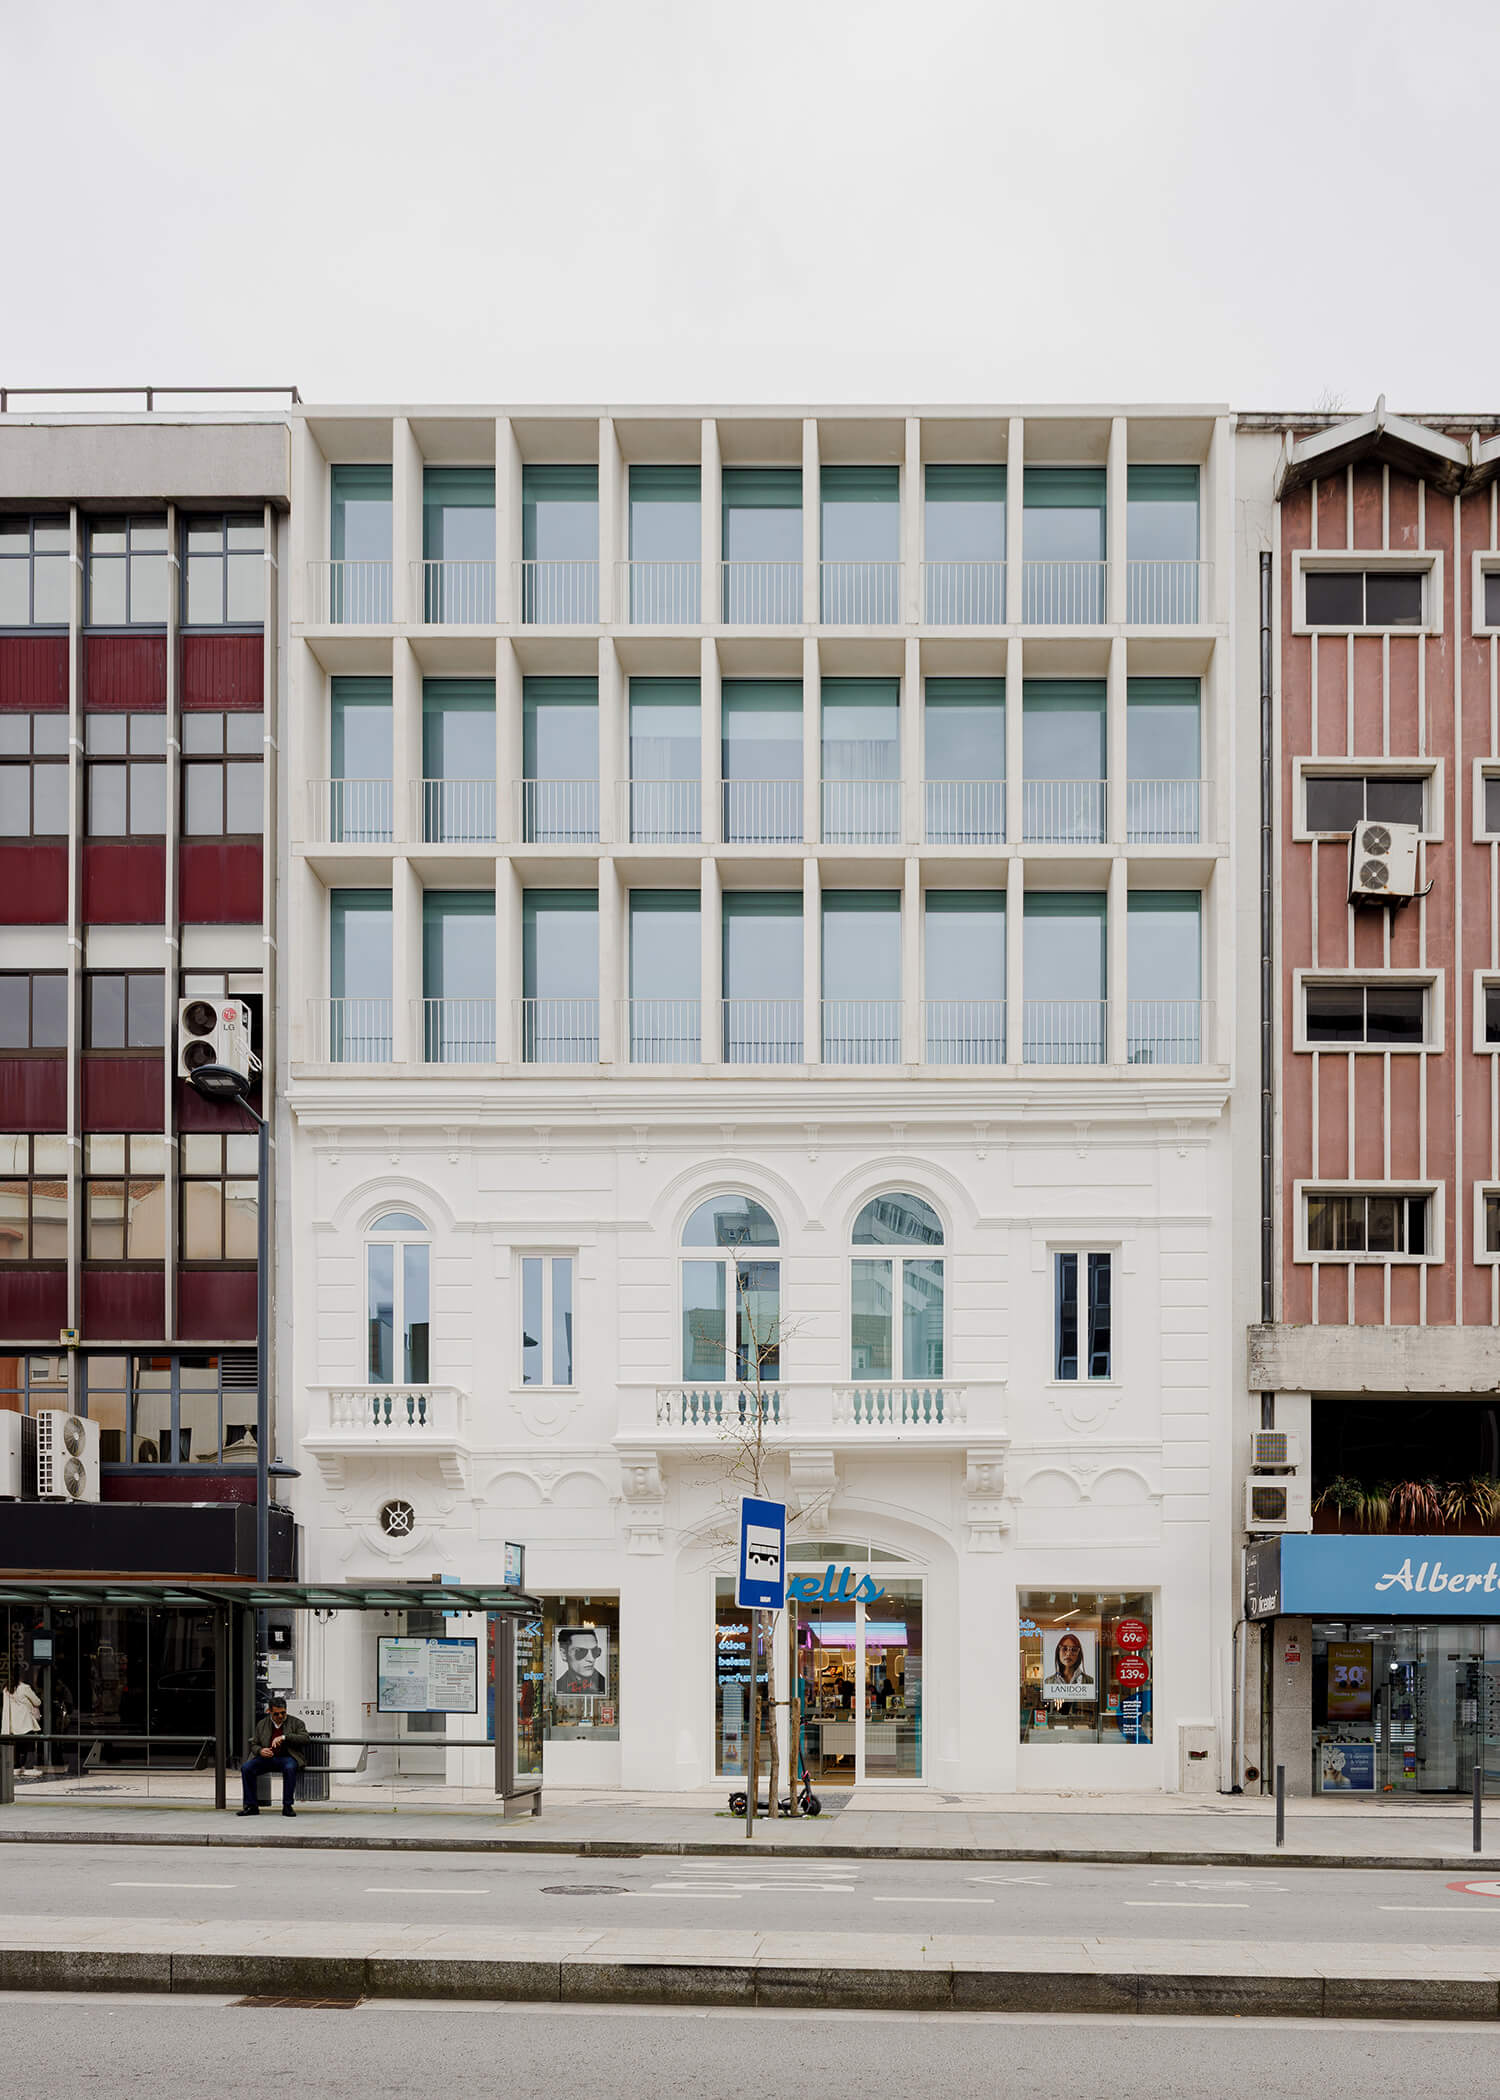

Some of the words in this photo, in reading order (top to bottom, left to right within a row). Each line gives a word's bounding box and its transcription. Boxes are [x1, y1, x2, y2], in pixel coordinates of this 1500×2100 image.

[223, 1023, 236, 1031] LG
[1374, 1558, 1500, 1593] Albert
[785, 1564, 886, 1603] ells
[718, 1640, 746, 1650] ótica
[718, 1656, 751, 1667] beleza
[718, 1672, 769, 1686] perfumari
[1050, 1685, 1088, 1694] LANIDOR
[649, 1862, 862, 1892] BUS
